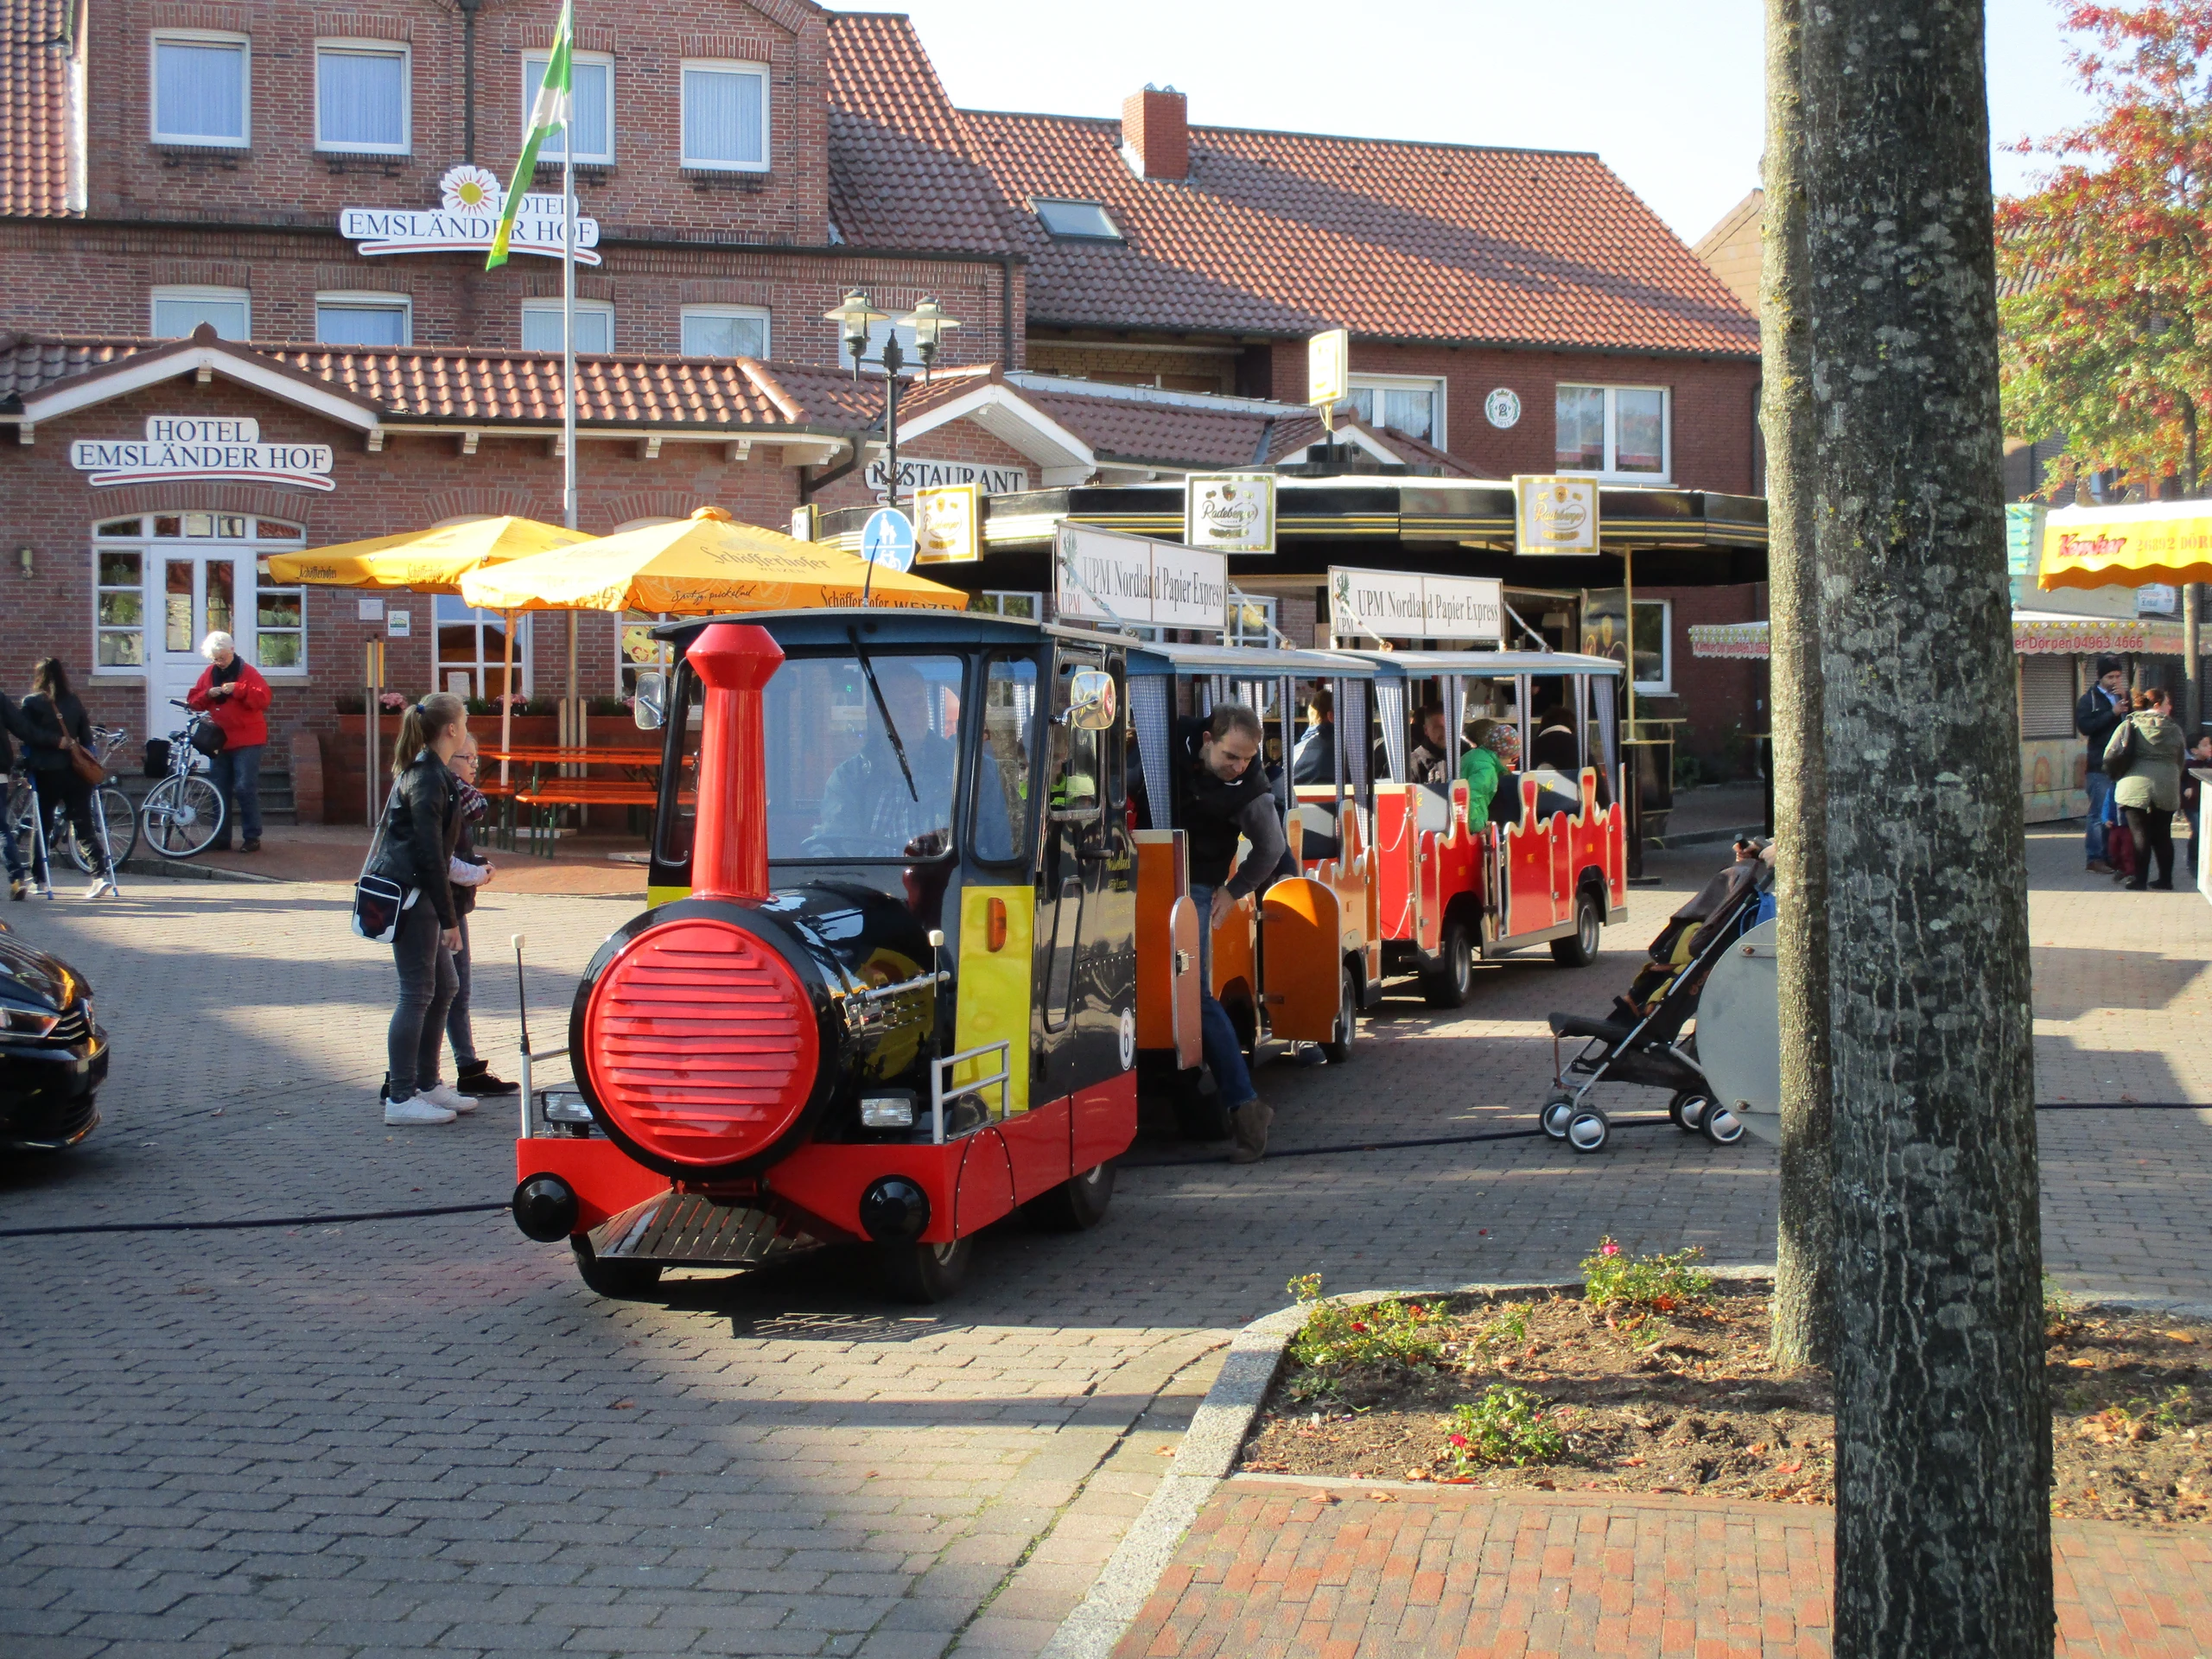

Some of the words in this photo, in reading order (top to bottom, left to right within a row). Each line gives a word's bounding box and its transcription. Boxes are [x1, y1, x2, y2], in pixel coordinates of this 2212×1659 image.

[536, 220, 593, 245] HOF
[154, 420, 251, 442] HOTEL
[77, 442, 262, 468] EMSLÄNDER
[269, 447, 327, 469] HOF
[1202, 500, 1256, 523] Radeberger
[700, 546, 831, 569] Schöfferhofer
[2057, 533, 2128, 558] Kemker
[2135, 537, 2176, 552] 26892
[1082, 556, 1111, 595] UPM
[1114, 560, 1160, 600] Nordland
[1162, 567, 1192, 612] Papier
[1192, 572, 1223, 614] Express
[1060, 592, 1080, 614] UPM
[1357, 589, 1385, 617] UPM
[1388, 590, 1433, 620] Nordland
[1435, 594, 1465, 627] Papier
[1465, 596, 1499, 623] Express
[1336, 617, 1354, 632] UPM
[2030, 636, 2072, 651] Dörpen
[1123, 1019, 1129, 1058] 6
